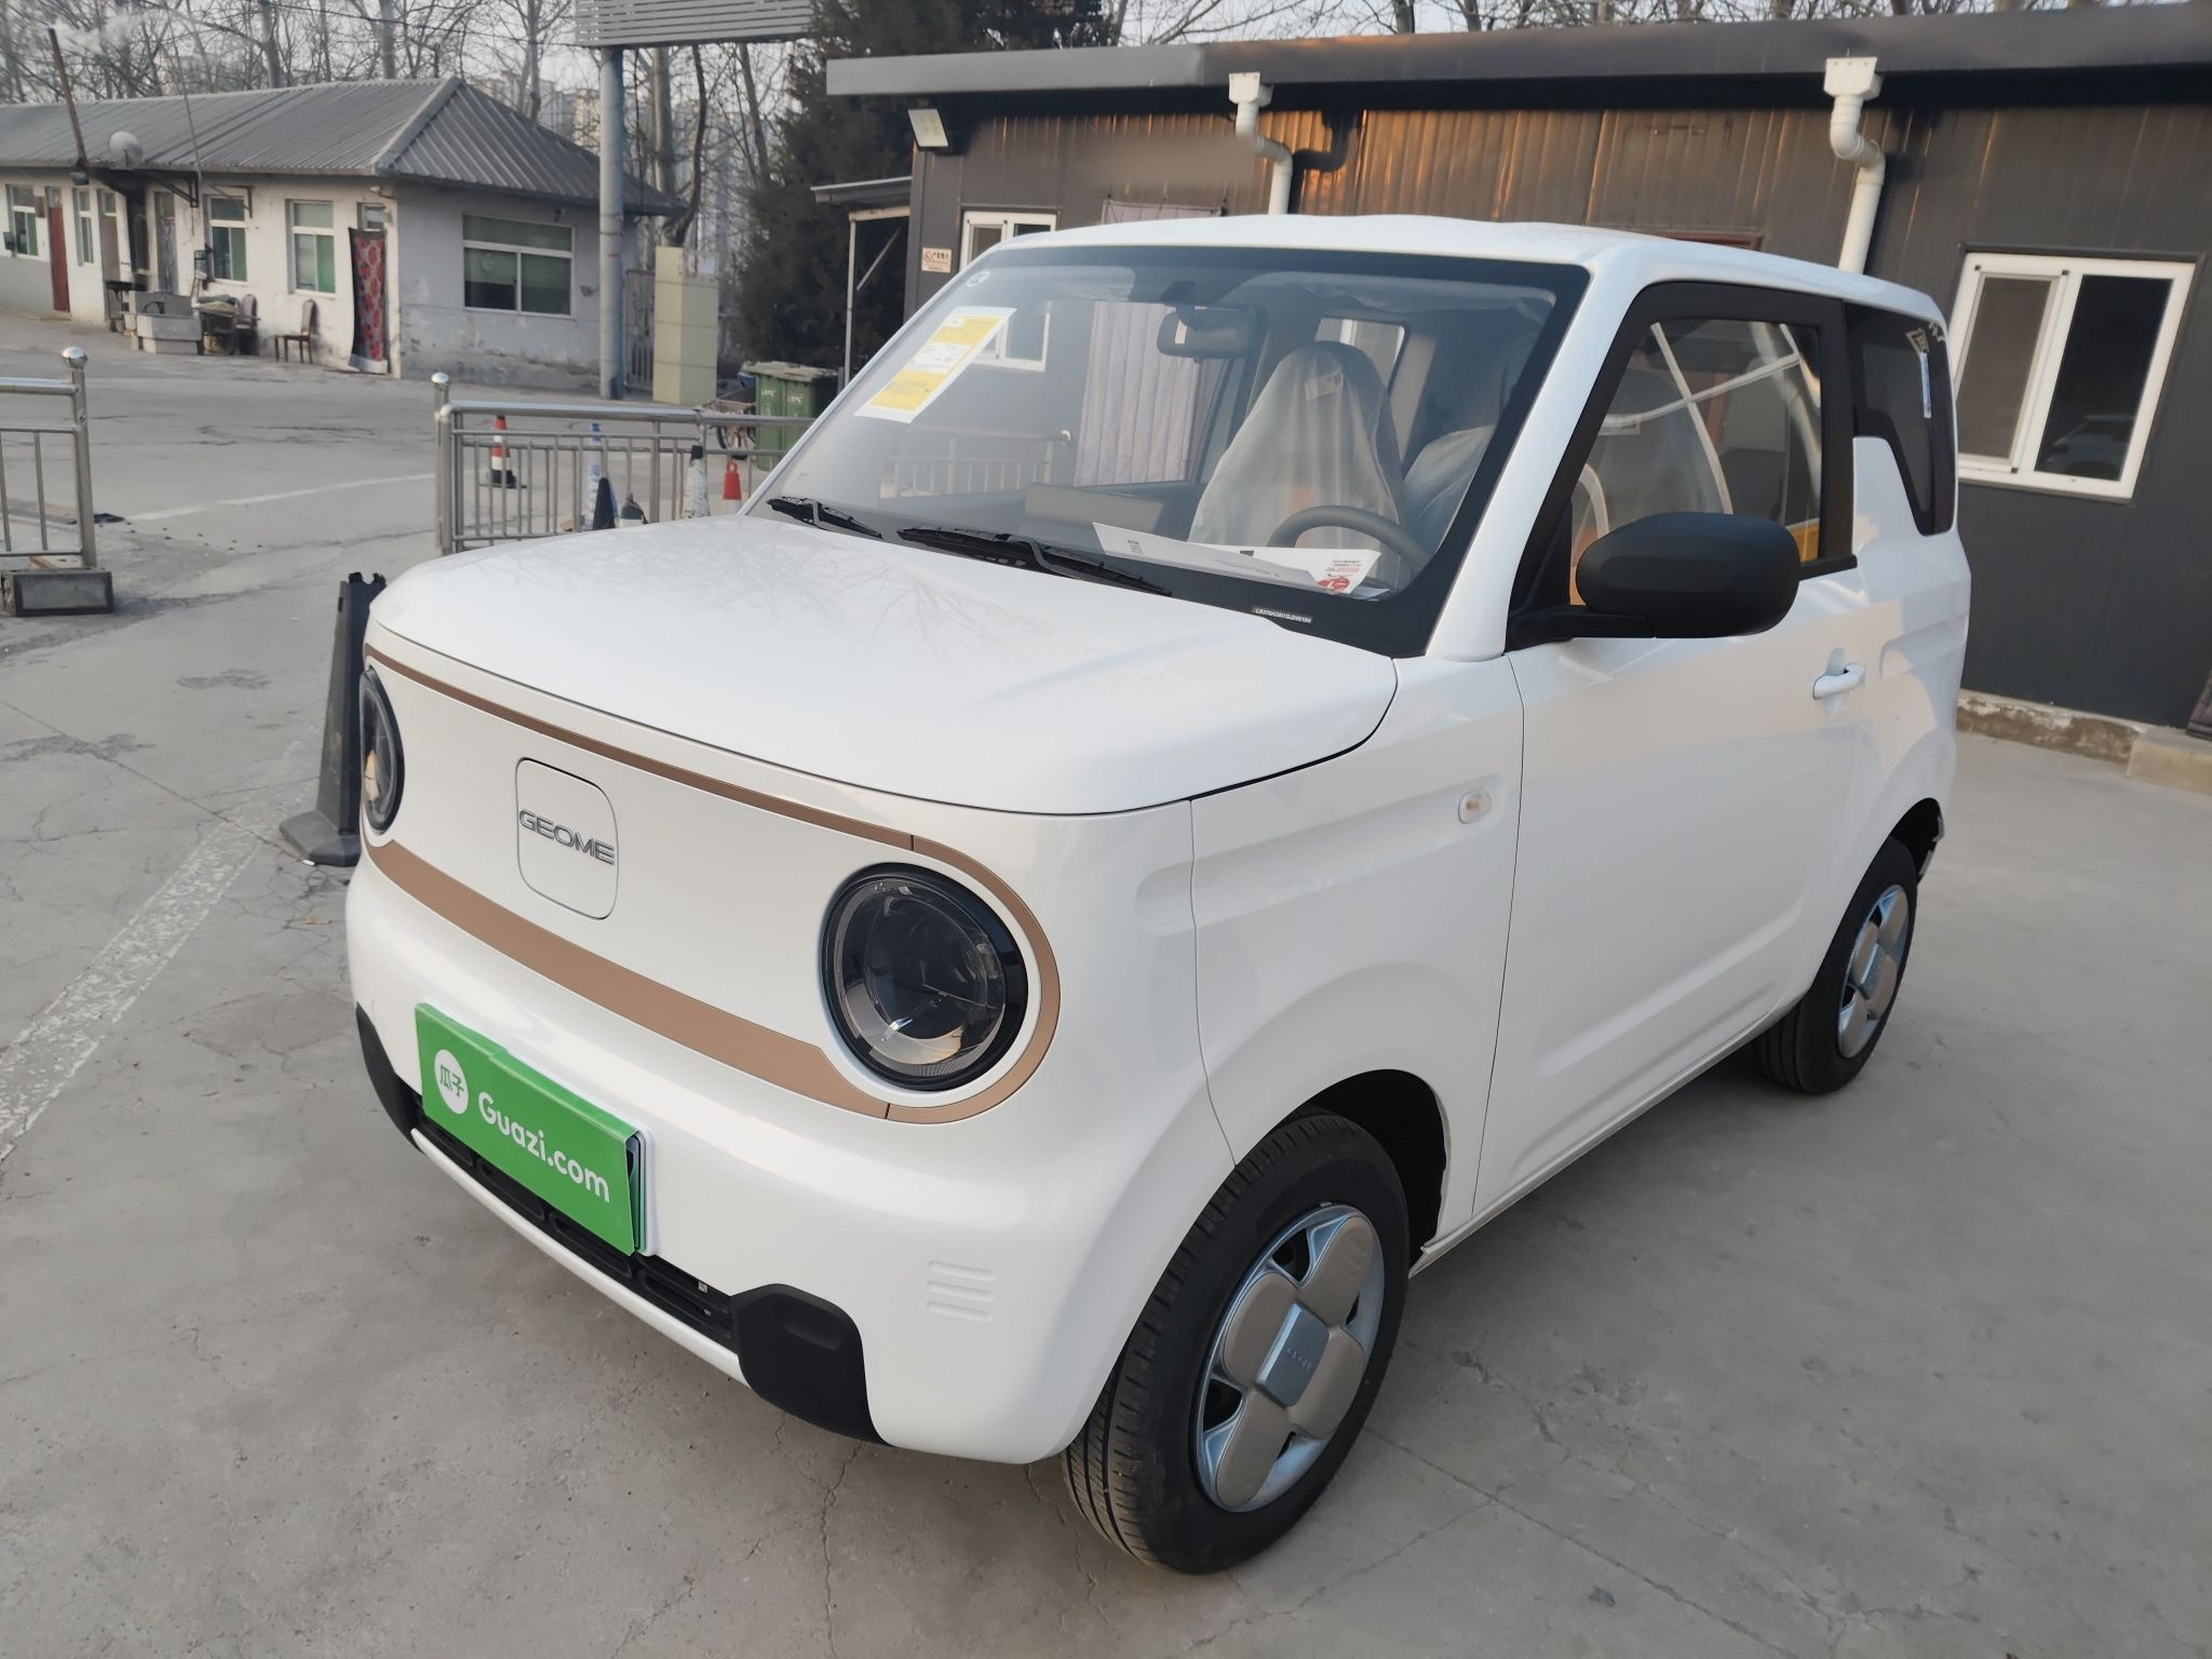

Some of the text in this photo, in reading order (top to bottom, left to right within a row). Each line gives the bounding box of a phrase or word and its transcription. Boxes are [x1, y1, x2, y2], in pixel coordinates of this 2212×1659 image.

[519, 808, 615, 866] GEOME
[440, 1064, 464, 1097] 瓜子
[478, 1091, 610, 1203] Guazi.com
